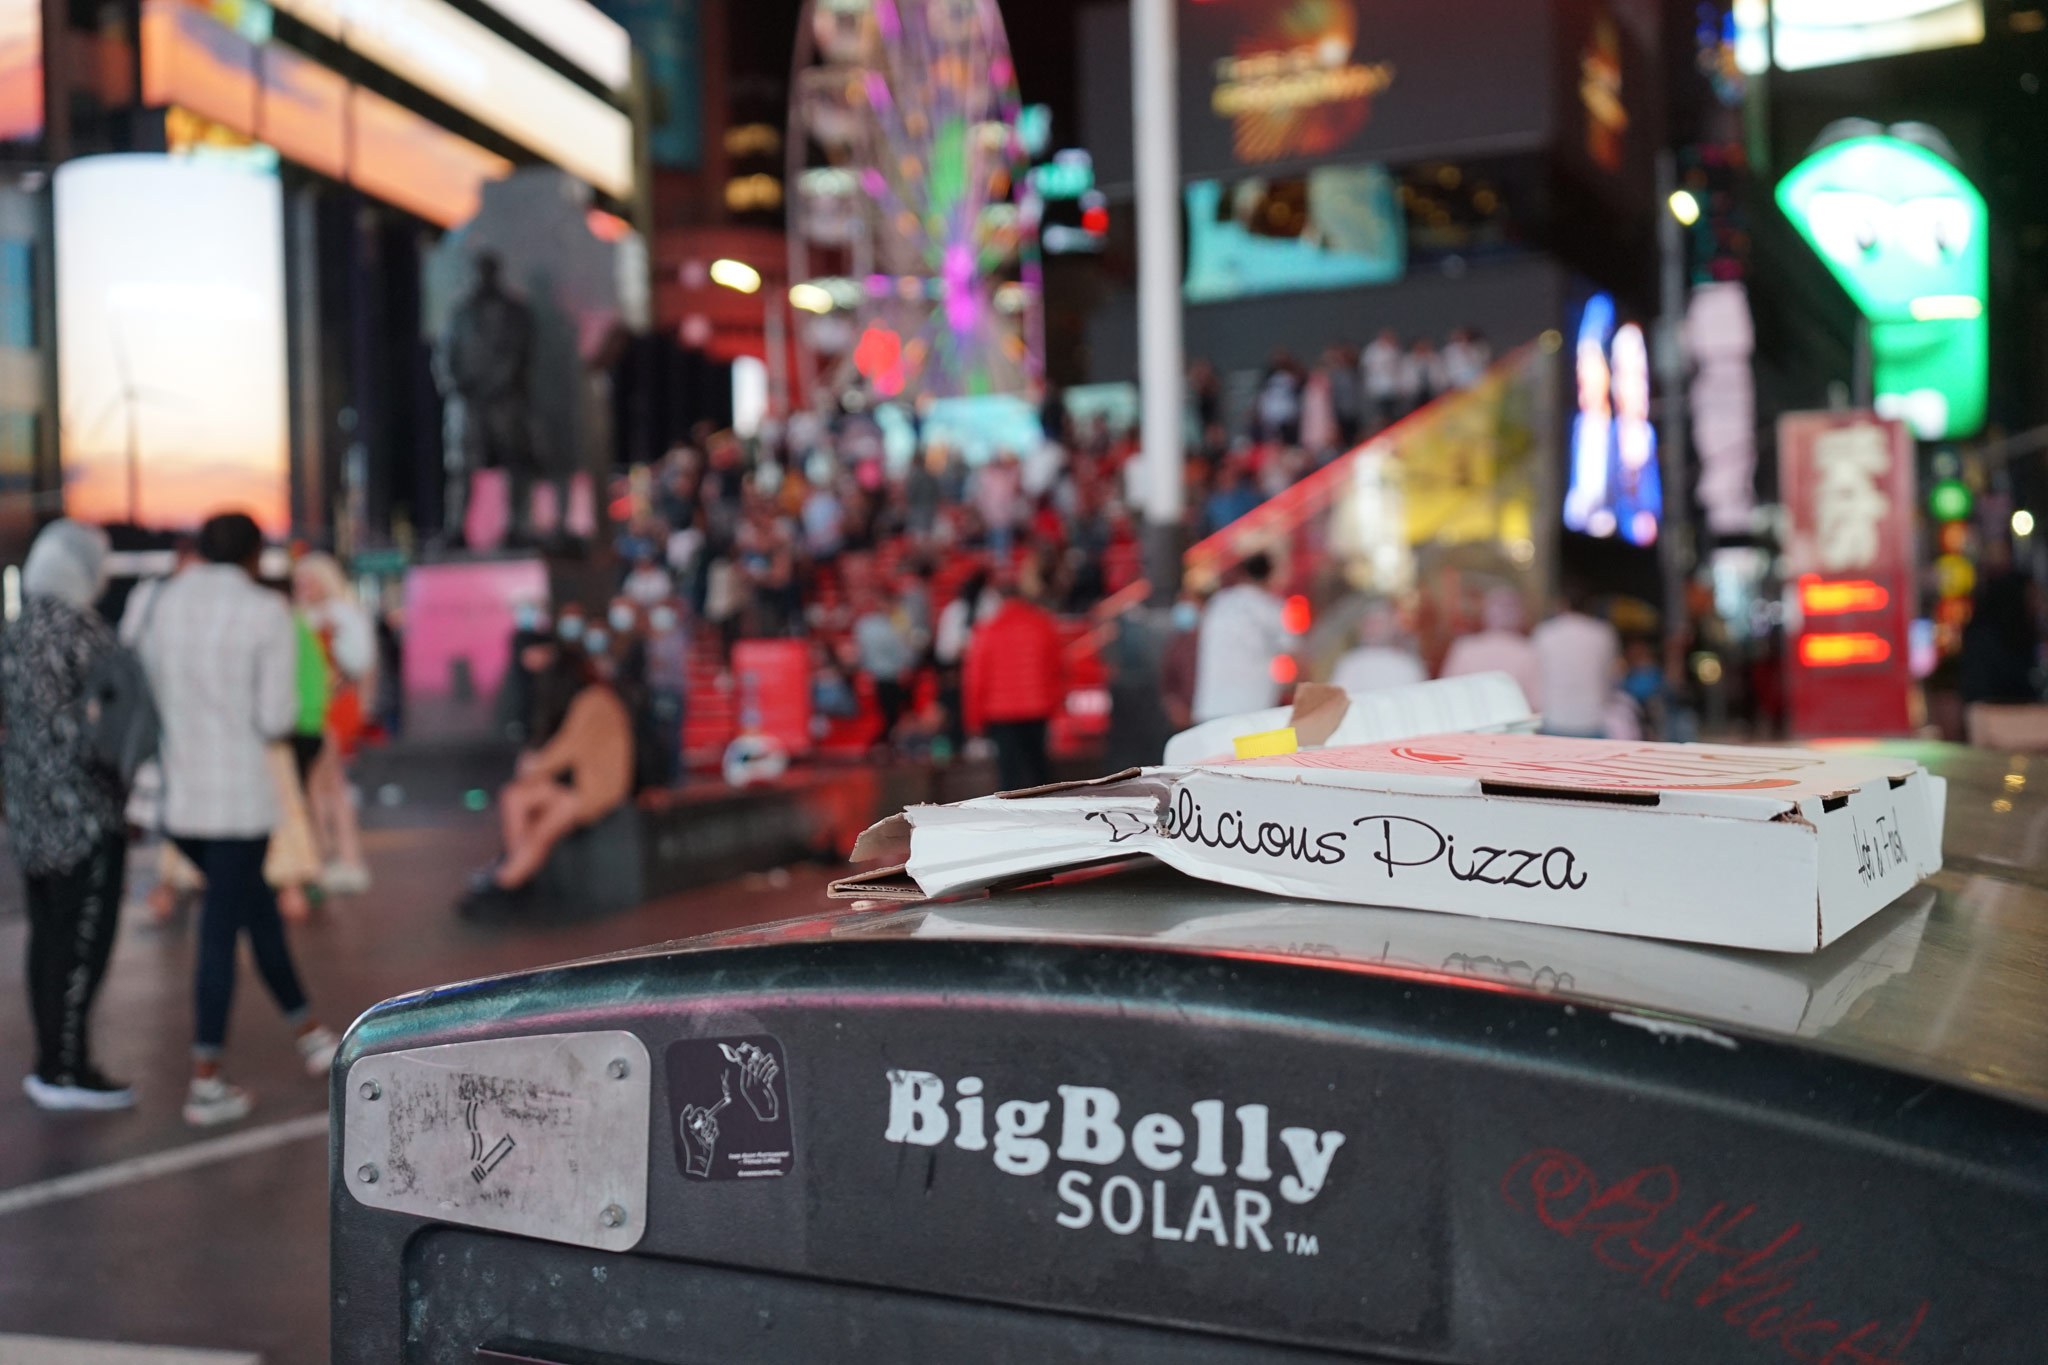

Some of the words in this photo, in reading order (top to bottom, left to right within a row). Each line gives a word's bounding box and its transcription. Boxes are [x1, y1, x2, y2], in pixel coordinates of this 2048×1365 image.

[1354, 815, 1587, 891] Pizza
[885, 1069, 1346, 1204] BigBelly
[1056, 1170, 1273, 1252] SOLAR
